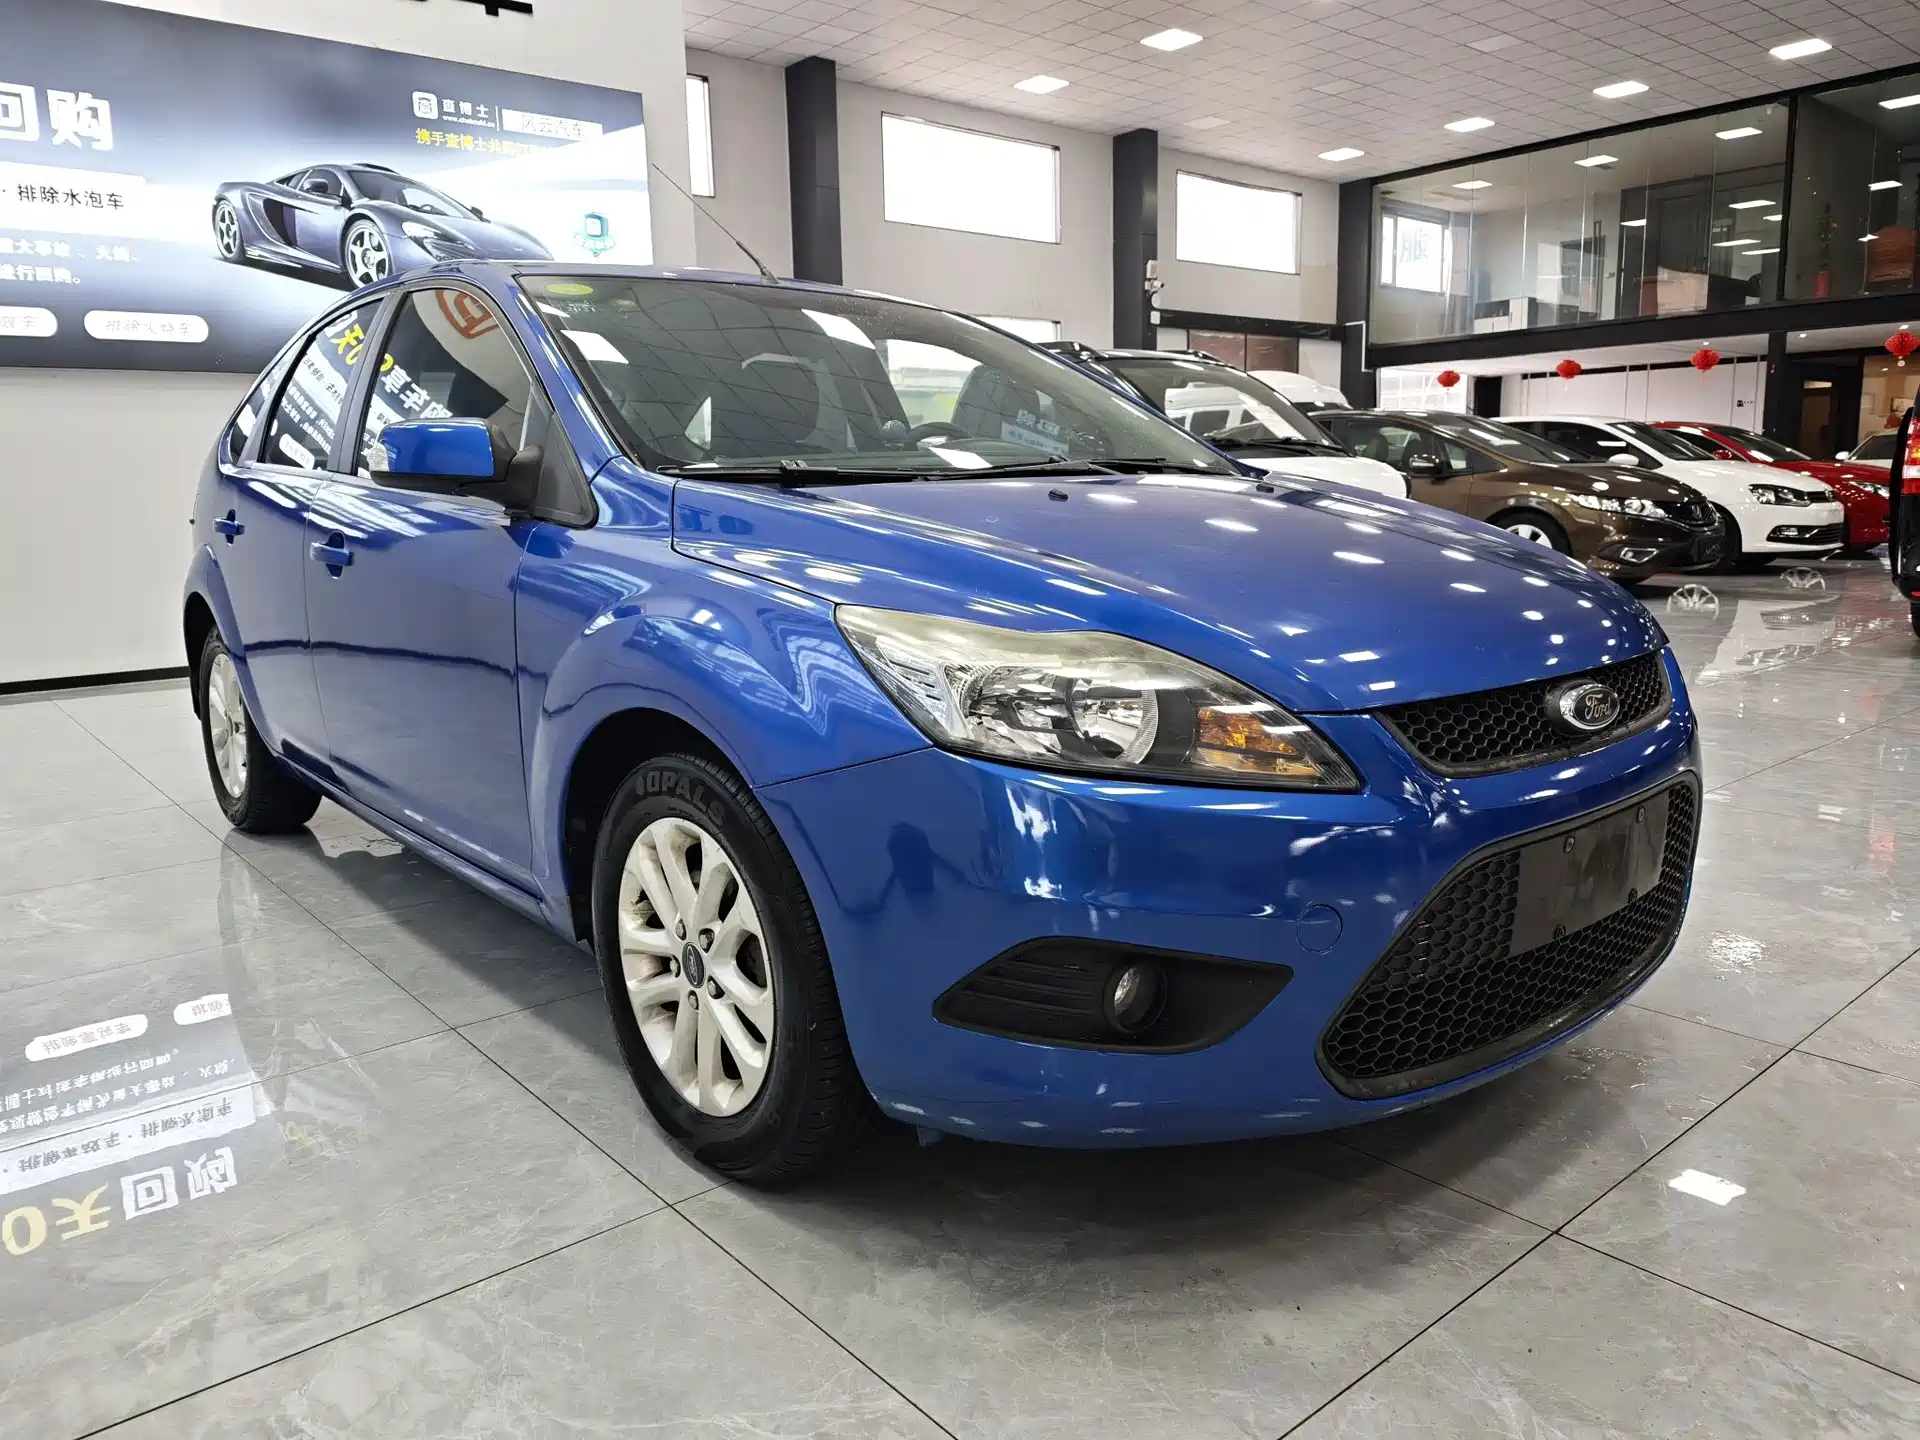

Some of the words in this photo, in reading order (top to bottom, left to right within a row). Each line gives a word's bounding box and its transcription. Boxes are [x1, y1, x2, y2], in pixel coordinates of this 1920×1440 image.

[442, 98, 489, 118] 查博士
[1585, 693, 1612, 720] Ford
